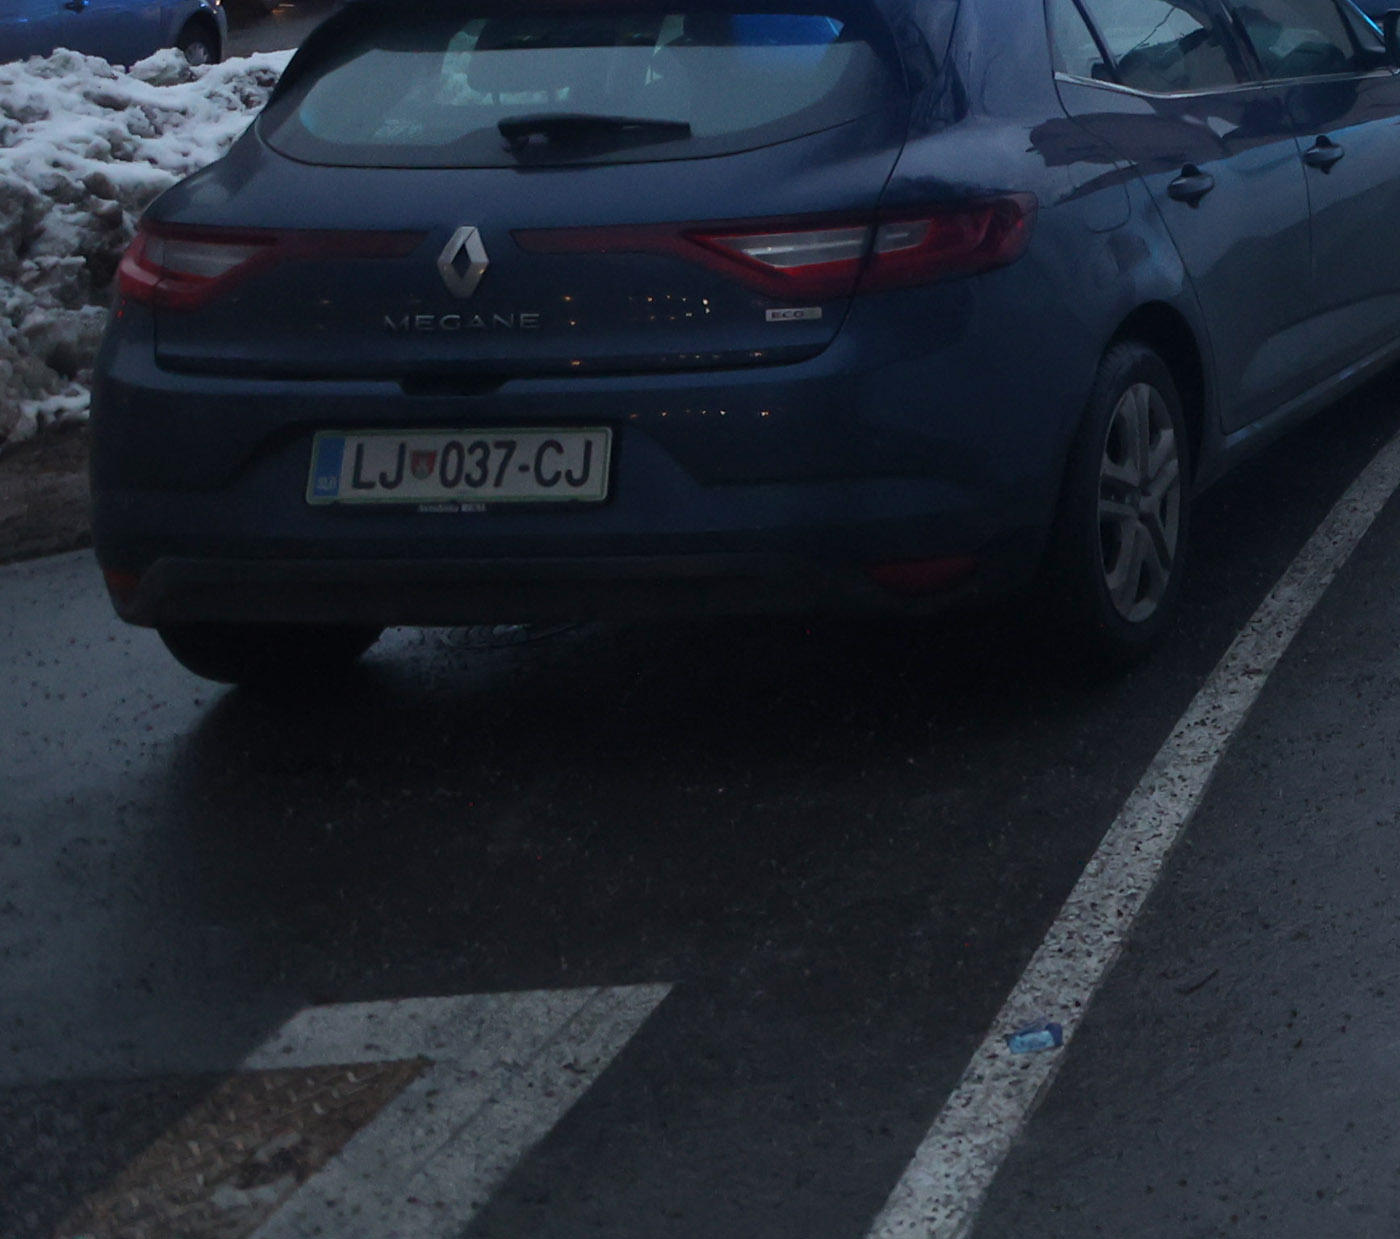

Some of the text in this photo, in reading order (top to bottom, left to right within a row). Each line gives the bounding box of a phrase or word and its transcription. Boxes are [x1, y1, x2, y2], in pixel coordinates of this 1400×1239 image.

[383, 313, 541, 331] MEGANE
[351, 439, 594, 490] LJ 037-CJ
